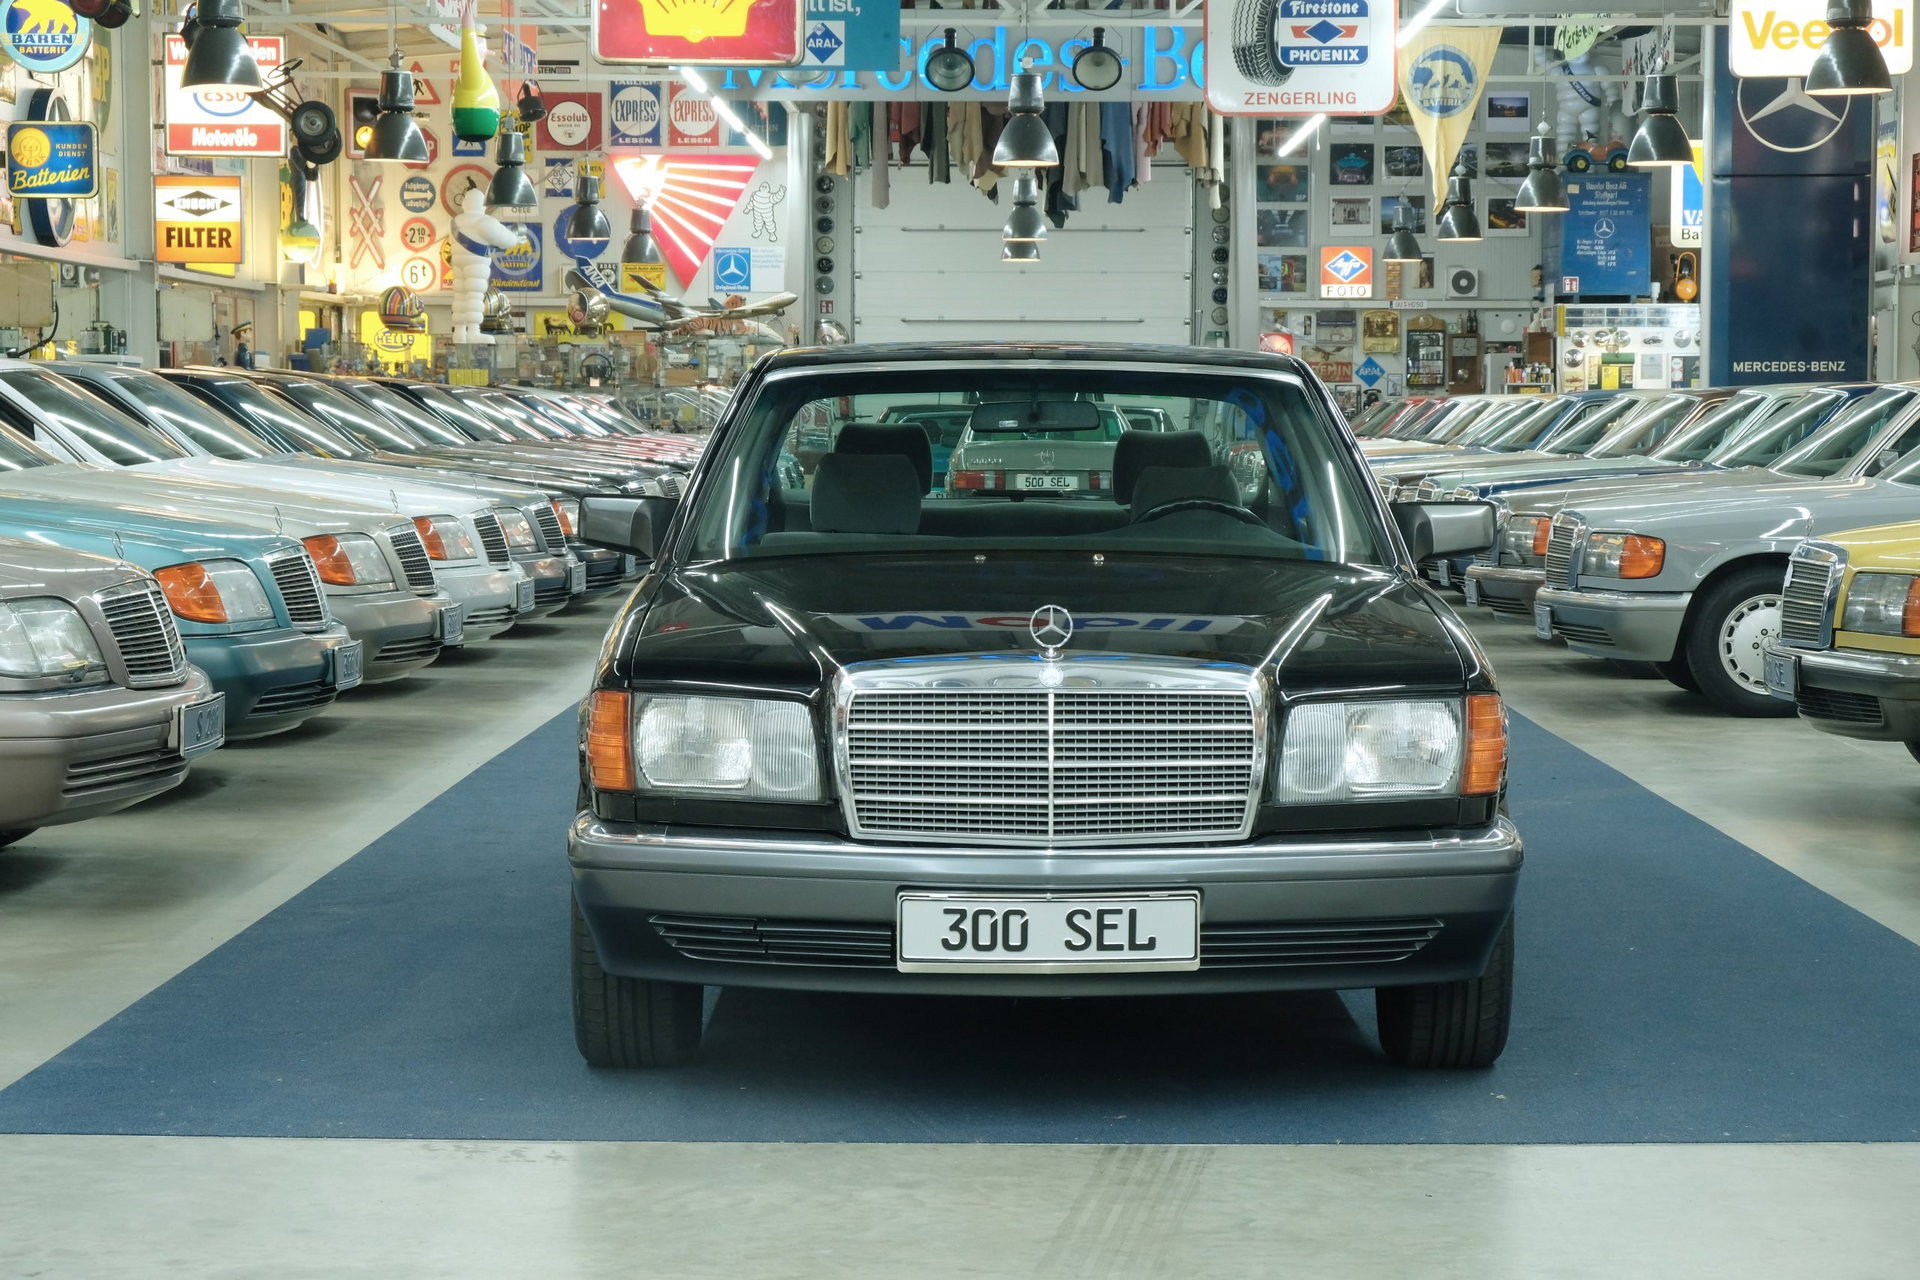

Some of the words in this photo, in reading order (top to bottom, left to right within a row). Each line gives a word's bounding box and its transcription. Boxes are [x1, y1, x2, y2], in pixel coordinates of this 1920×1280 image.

[1289, 1, 1360, 16] Firestone
[1741, 8, 1904, 50] Veeol
[12, 33, 73, 44] BÄREN
[807, 38, 838, 48] ARAL
[19, 46, 67, 54] BATTERIE
[1289, 49, 1360, 62] PHOENIX
[1244, 92, 1357, 105] ZENGERLING
[550, 113, 588, 122] Essolub
[615, 100, 656, 122] EXPRESS
[674, 100, 715, 122] EXPRESS
[191, 127, 258, 147] Motoröle
[11, 164, 91, 191] Batterien
[166, 227, 232, 248] FILTER
[581, 265, 606, 288] ANA
[1326, 286, 1367, 296] FOTO
[1358, 367, 1382, 376] ARAL
[1733, 361, 1846, 373] MERCEDES-BENZ
[1025, 476, 1044, 488] 500
[1050, 475, 1070, 487] SEL
[940, 907, 1029, 952] 300
[1063, 907, 1157, 952] SEL
